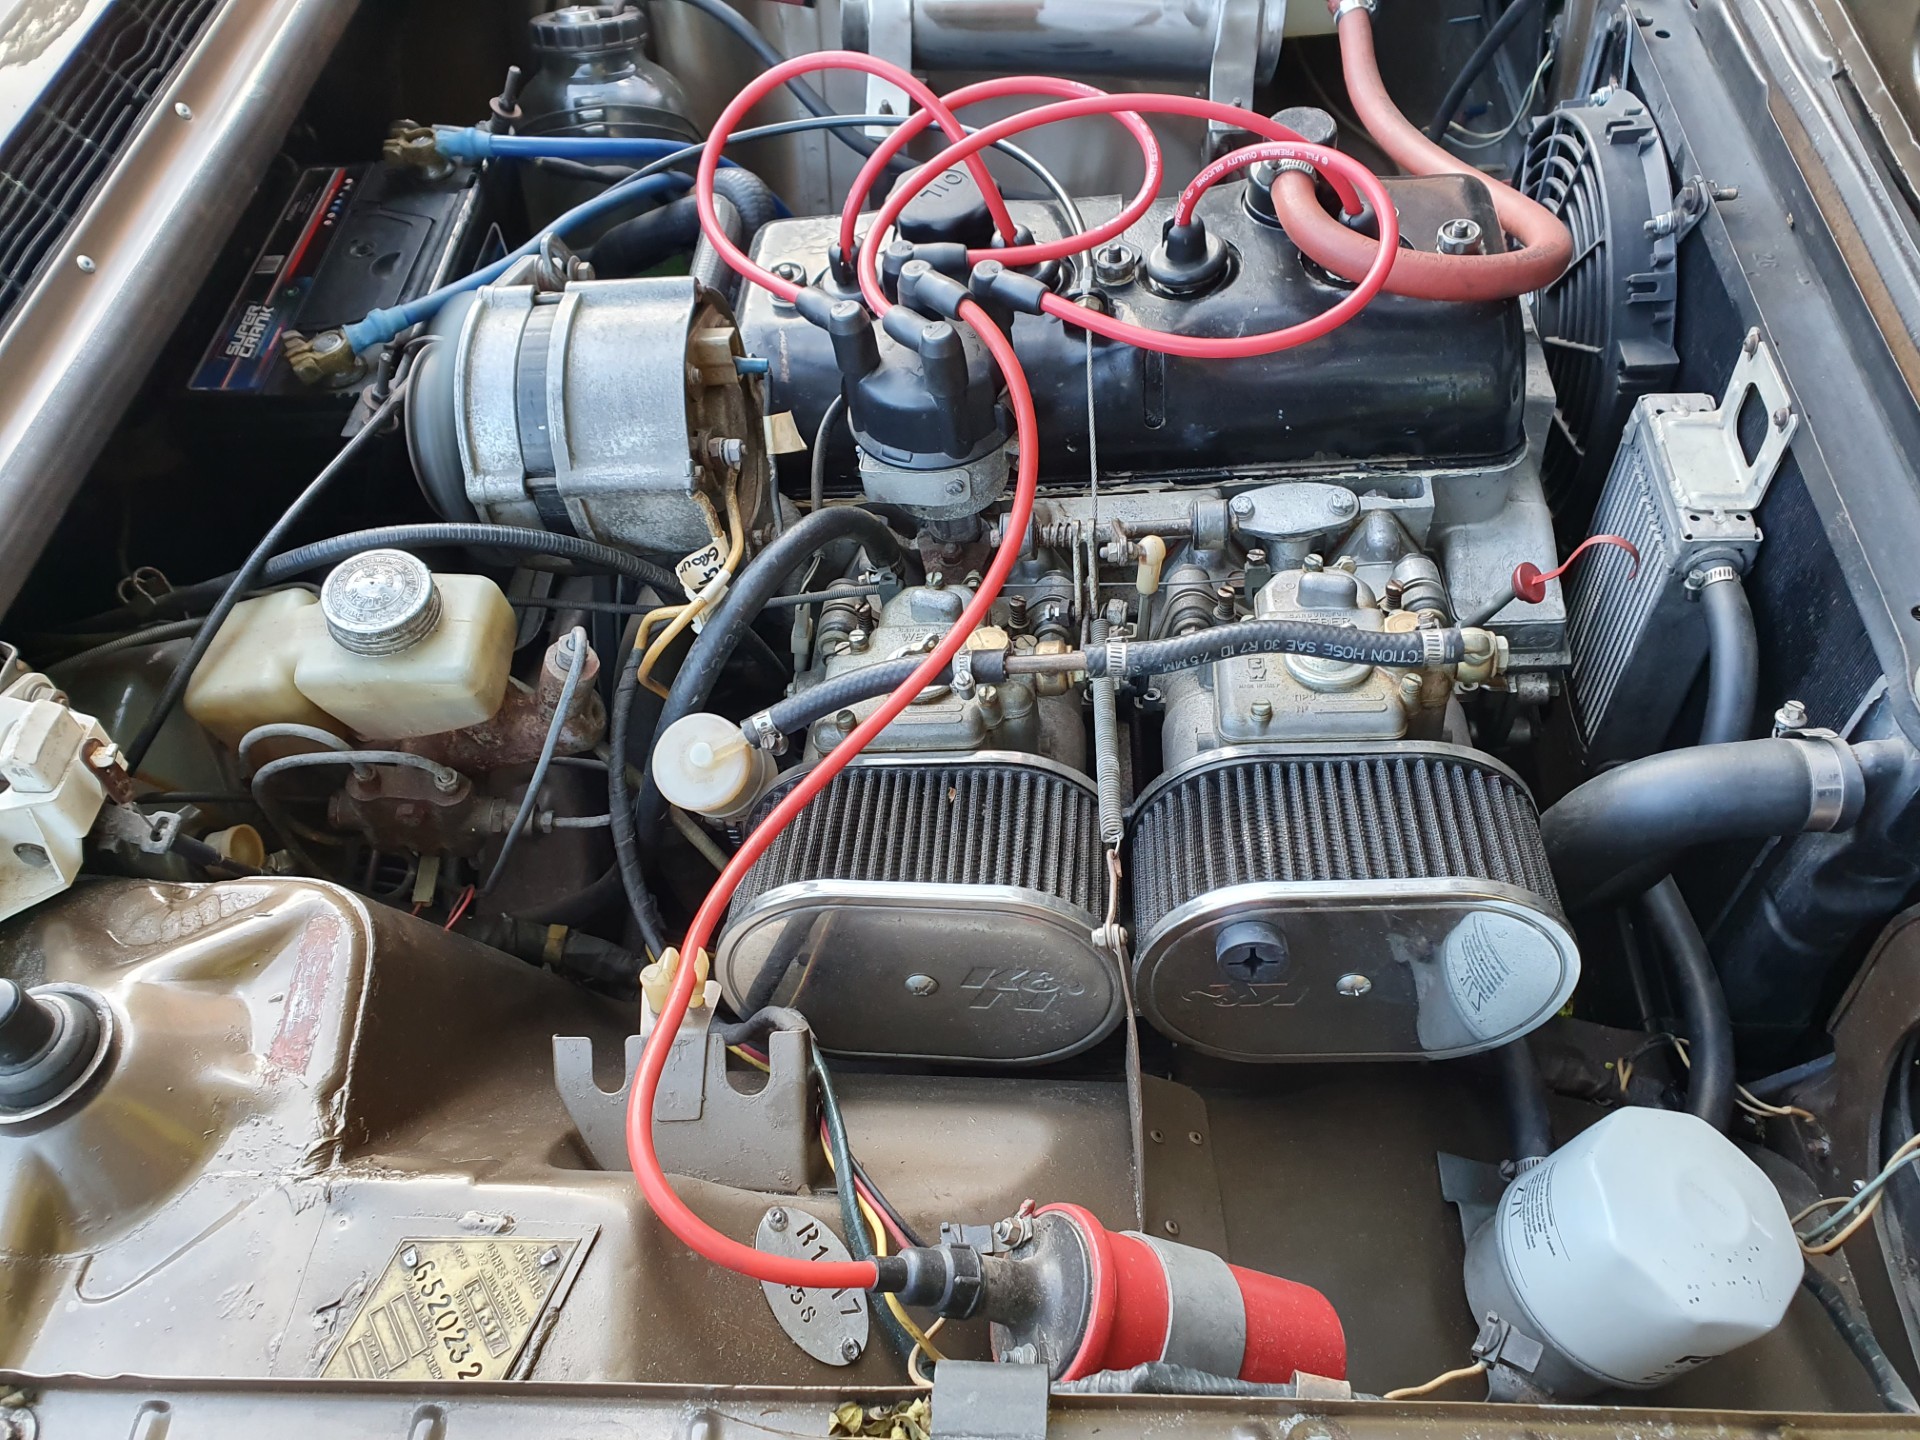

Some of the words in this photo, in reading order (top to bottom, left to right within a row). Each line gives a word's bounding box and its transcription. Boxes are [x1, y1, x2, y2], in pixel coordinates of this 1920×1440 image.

[1227, 151, 1257, 167] QUALITY
[1261, 148, 1295, 157] PREMIUM
[920, 173, 962, 198] OIL
[1196, 163, 1225, 188] SILICONE
[225, 304, 262, 356] SUPER
[238, 306, 274, 358] CRANK
[1240, 641, 1258, 653] R7
[1264, 639, 1281, 651] 30
[1287, 639, 1317, 653] SAE
[1324, 643, 1365, 661] HOSE
[454, 1245, 470, 1271] TYPE
[796, 1222, 863, 1315] R117
[486, 1242, 508, 1280] USINES
[503, 1280, 530, 1327] RENAULT
[511, 1267, 524, 1285] DES
[513, 1244, 545, 1300] NATIONALE
[453, 1289, 475, 1331] NUMERO
[485, 1270, 517, 1329] BILLANCOURT
